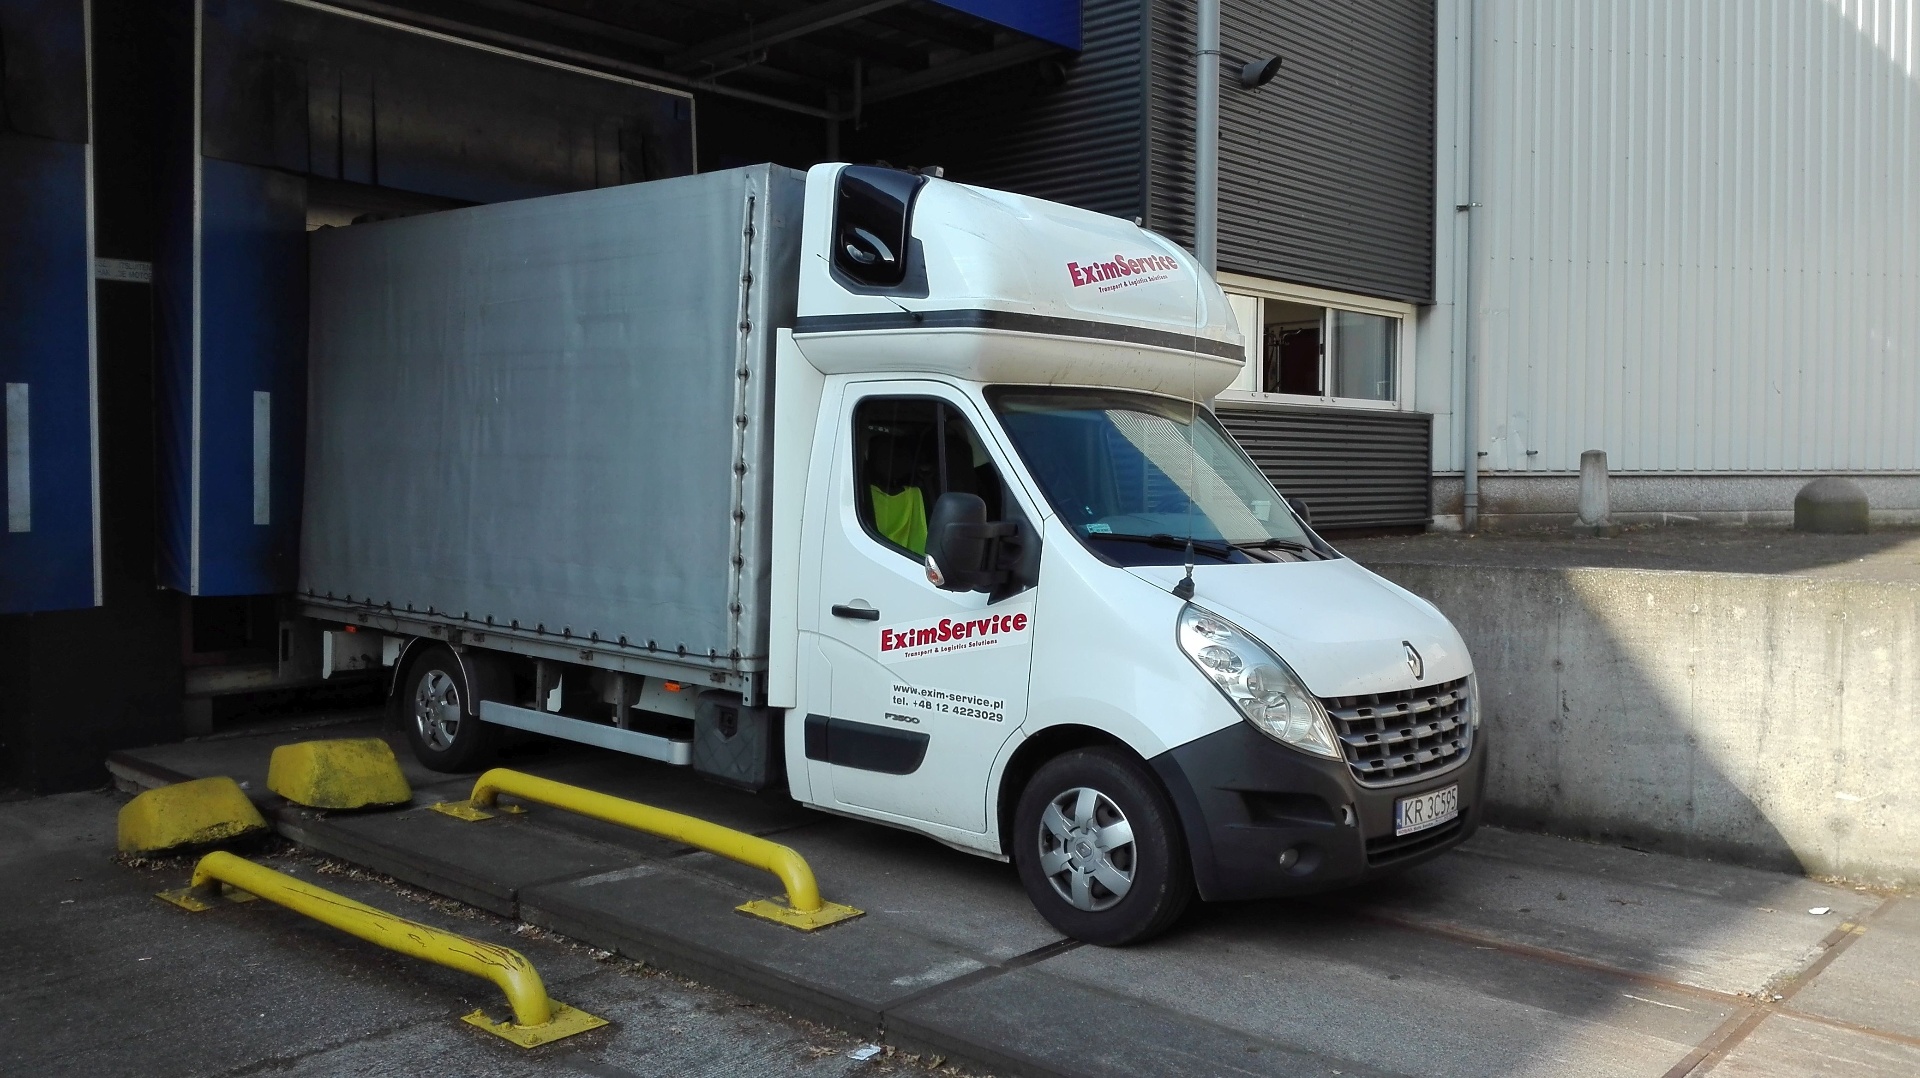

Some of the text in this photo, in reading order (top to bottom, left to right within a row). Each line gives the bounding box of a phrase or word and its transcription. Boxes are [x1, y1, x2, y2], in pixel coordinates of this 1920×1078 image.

[1067, 254, 1178, 287] EximService
[1099, 282, 1122, 293] Transport
[1129, 278, 1148, 287] Logistics
[881, 613, 1028, 651] EximService
[905, 648, 933, 658] Transport
[941, 643, 967, 652] Logistics
[968, 639, 998, 648] Solutions
[893, 684, 1004, 709] www.exim-service.pl
[893, 695, 1003, 722] tel. +48 12 4223029
[1405, 799, 1423, 826] KR
[1427, 788, 1456, 819] 3C595
